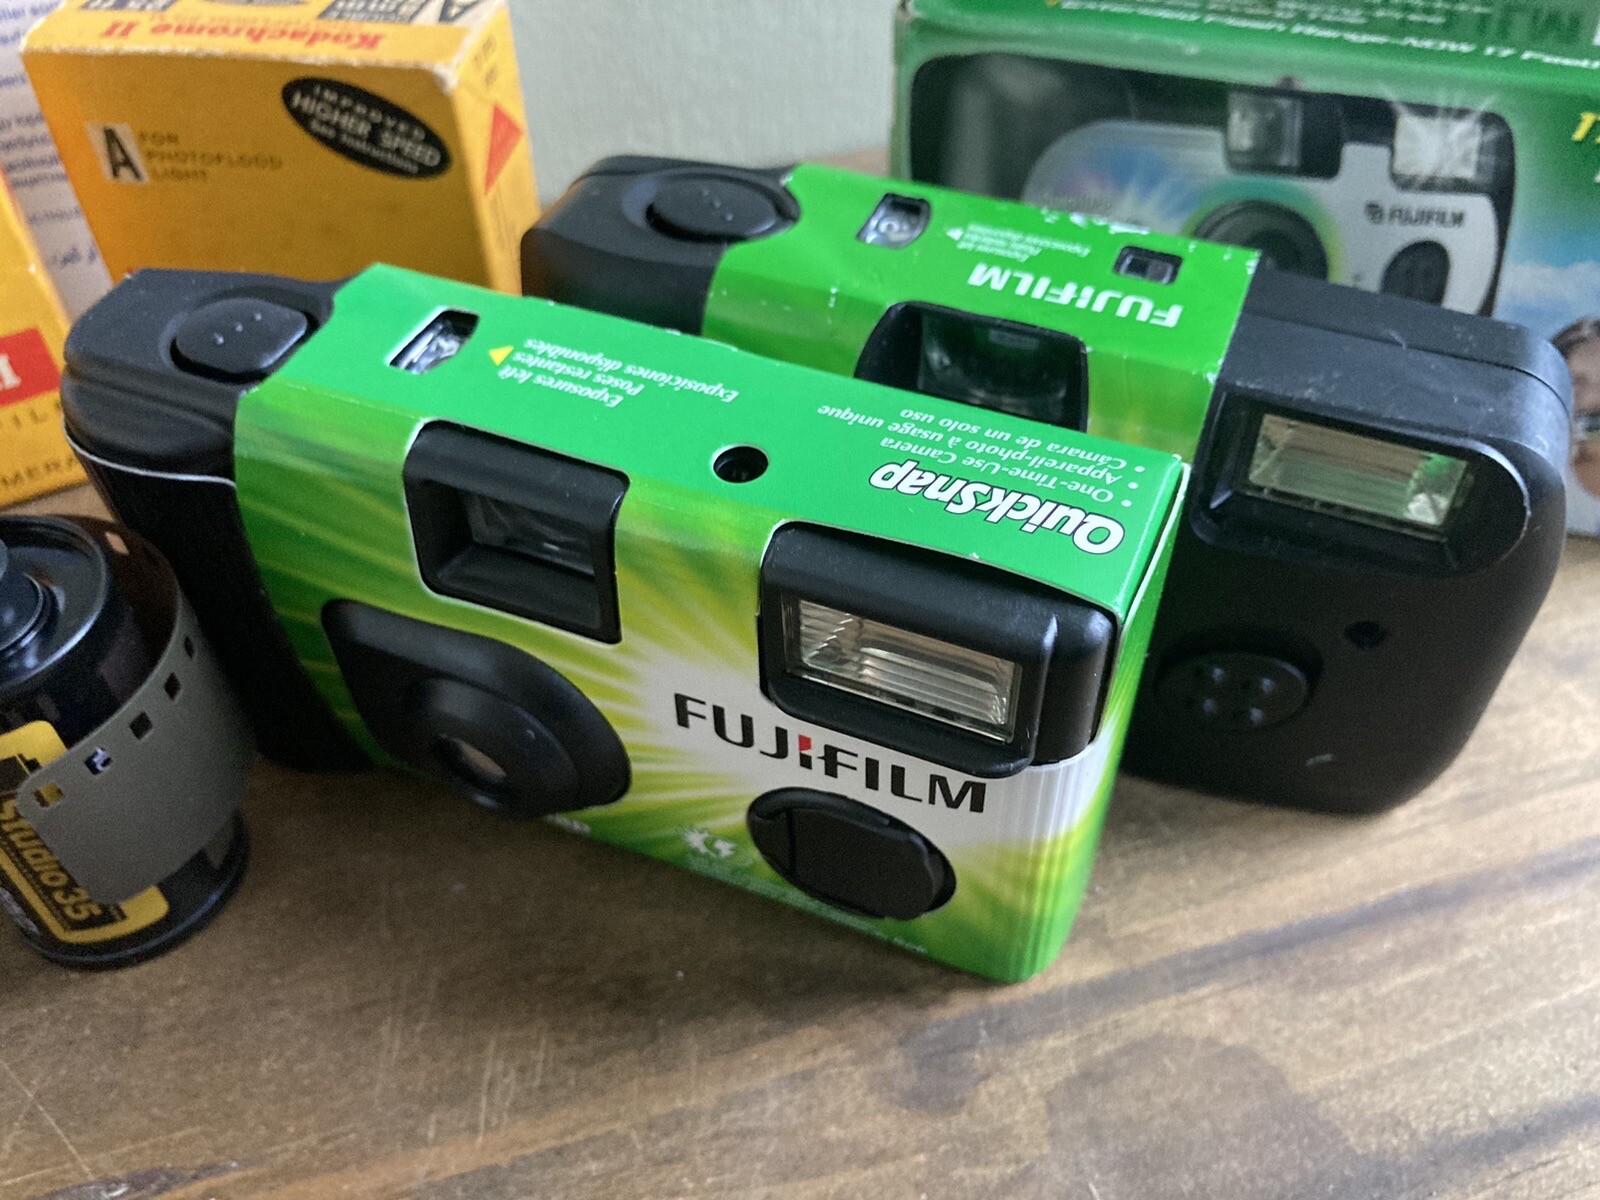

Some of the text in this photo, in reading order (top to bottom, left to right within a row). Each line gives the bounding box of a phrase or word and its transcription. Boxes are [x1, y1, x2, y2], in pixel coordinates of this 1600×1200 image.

[151, 23, 384, 49] Kodachrome
[291, 91, 442, 167] HIGHER SPEED
[314, 84, 426, 142] IMPROVED
[103, 125, 142, 183] A
[967, 262, 1184, 328] FUJIFILM
[498, 364, 624, 408] Exposures left
[512, 352, 645, 396] Poses restantes
[524, 338, 739, 403] Exposiciones disponibles
[817, 405, 1123, 486] Appareil-photo à usage unique
[880, 437, 1114, 503] One-Time-Use Camera
[900, 408, 1127, 470] Cámara de un solo uso
[868, 458, 1126, 555] QuickSnap
[674, 692, 987, 813] FUJIFILM
